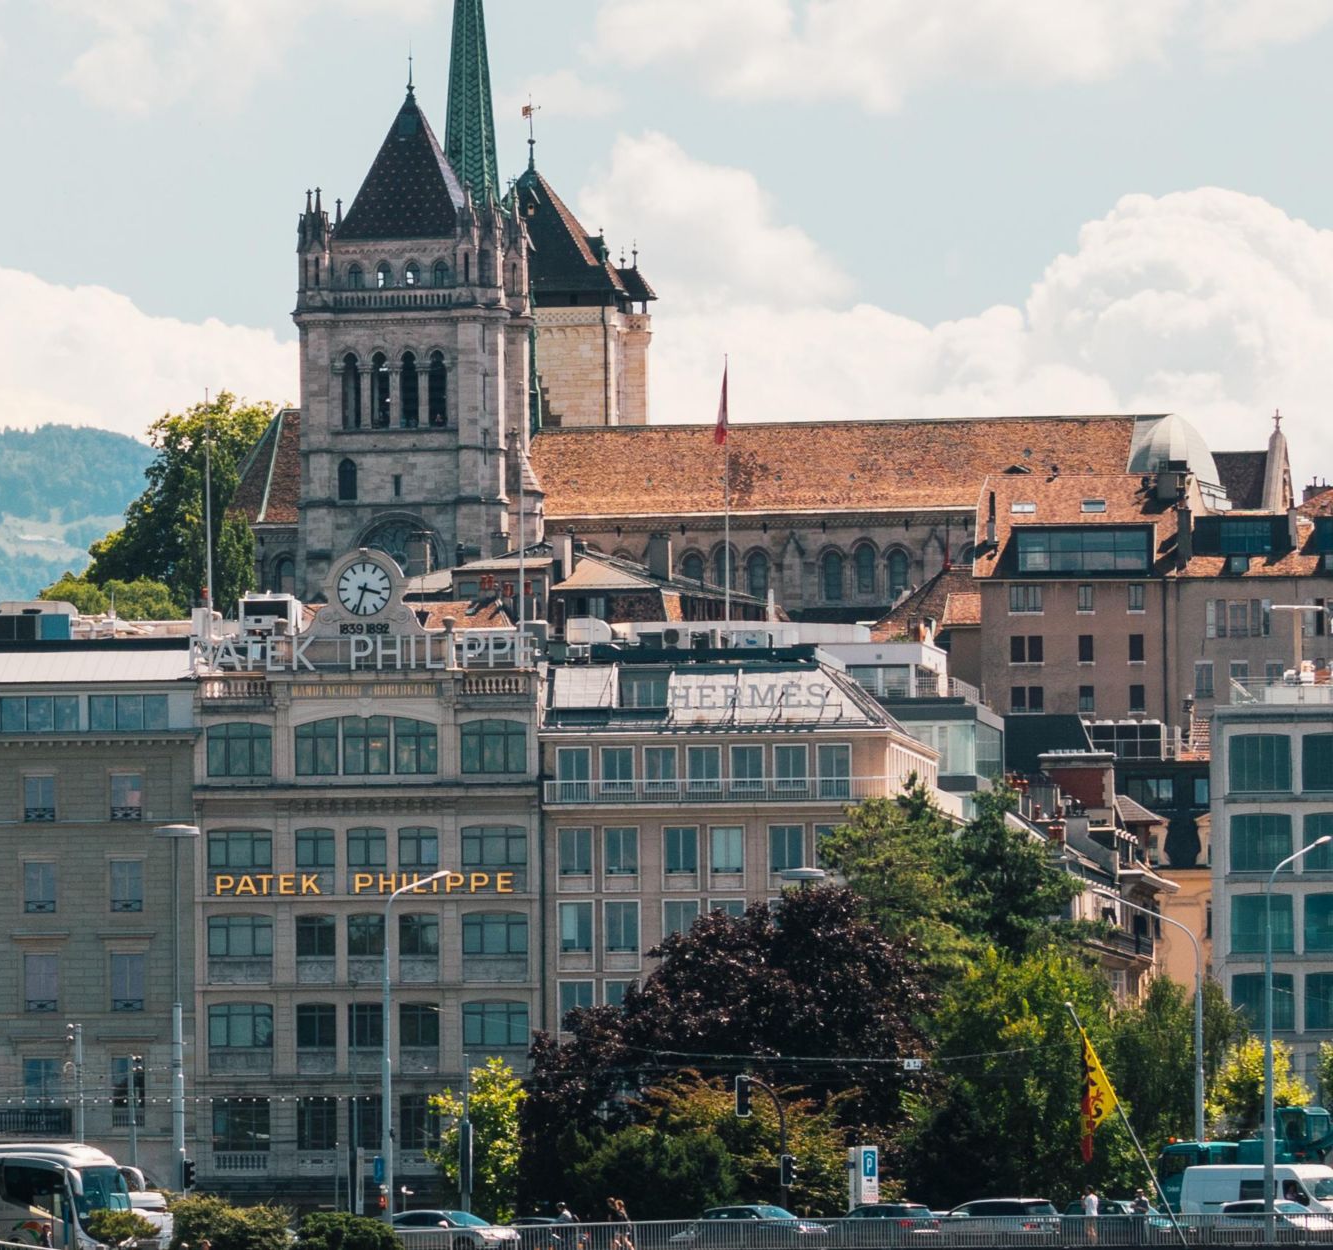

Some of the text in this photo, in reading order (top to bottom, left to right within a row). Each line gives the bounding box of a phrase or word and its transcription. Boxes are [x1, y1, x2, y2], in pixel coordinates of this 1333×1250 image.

[339, 623, 390, 635] 1839 1892
[189, 631, 534, 671] PATEK PHILIPPE
[215, 872, 516, 895] PATEK PHILIPPE
